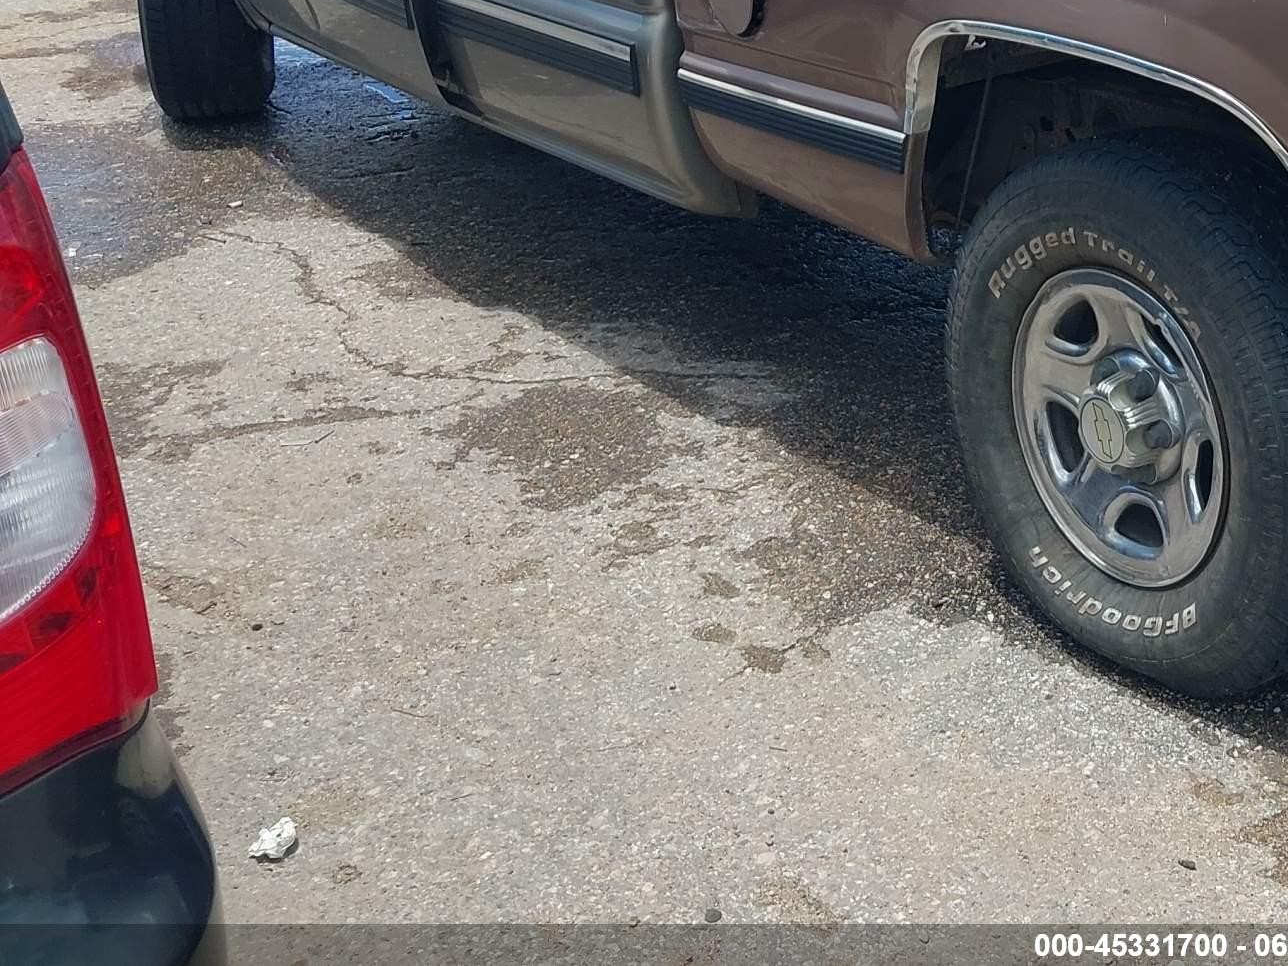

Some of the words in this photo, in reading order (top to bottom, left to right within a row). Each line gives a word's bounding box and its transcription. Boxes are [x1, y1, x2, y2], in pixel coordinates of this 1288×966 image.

[988, 227, 1076, 299] Rugged
[1083, 231, 1155, 282] Trail
[1029, 545, 1197, 637] BFGoodrich
